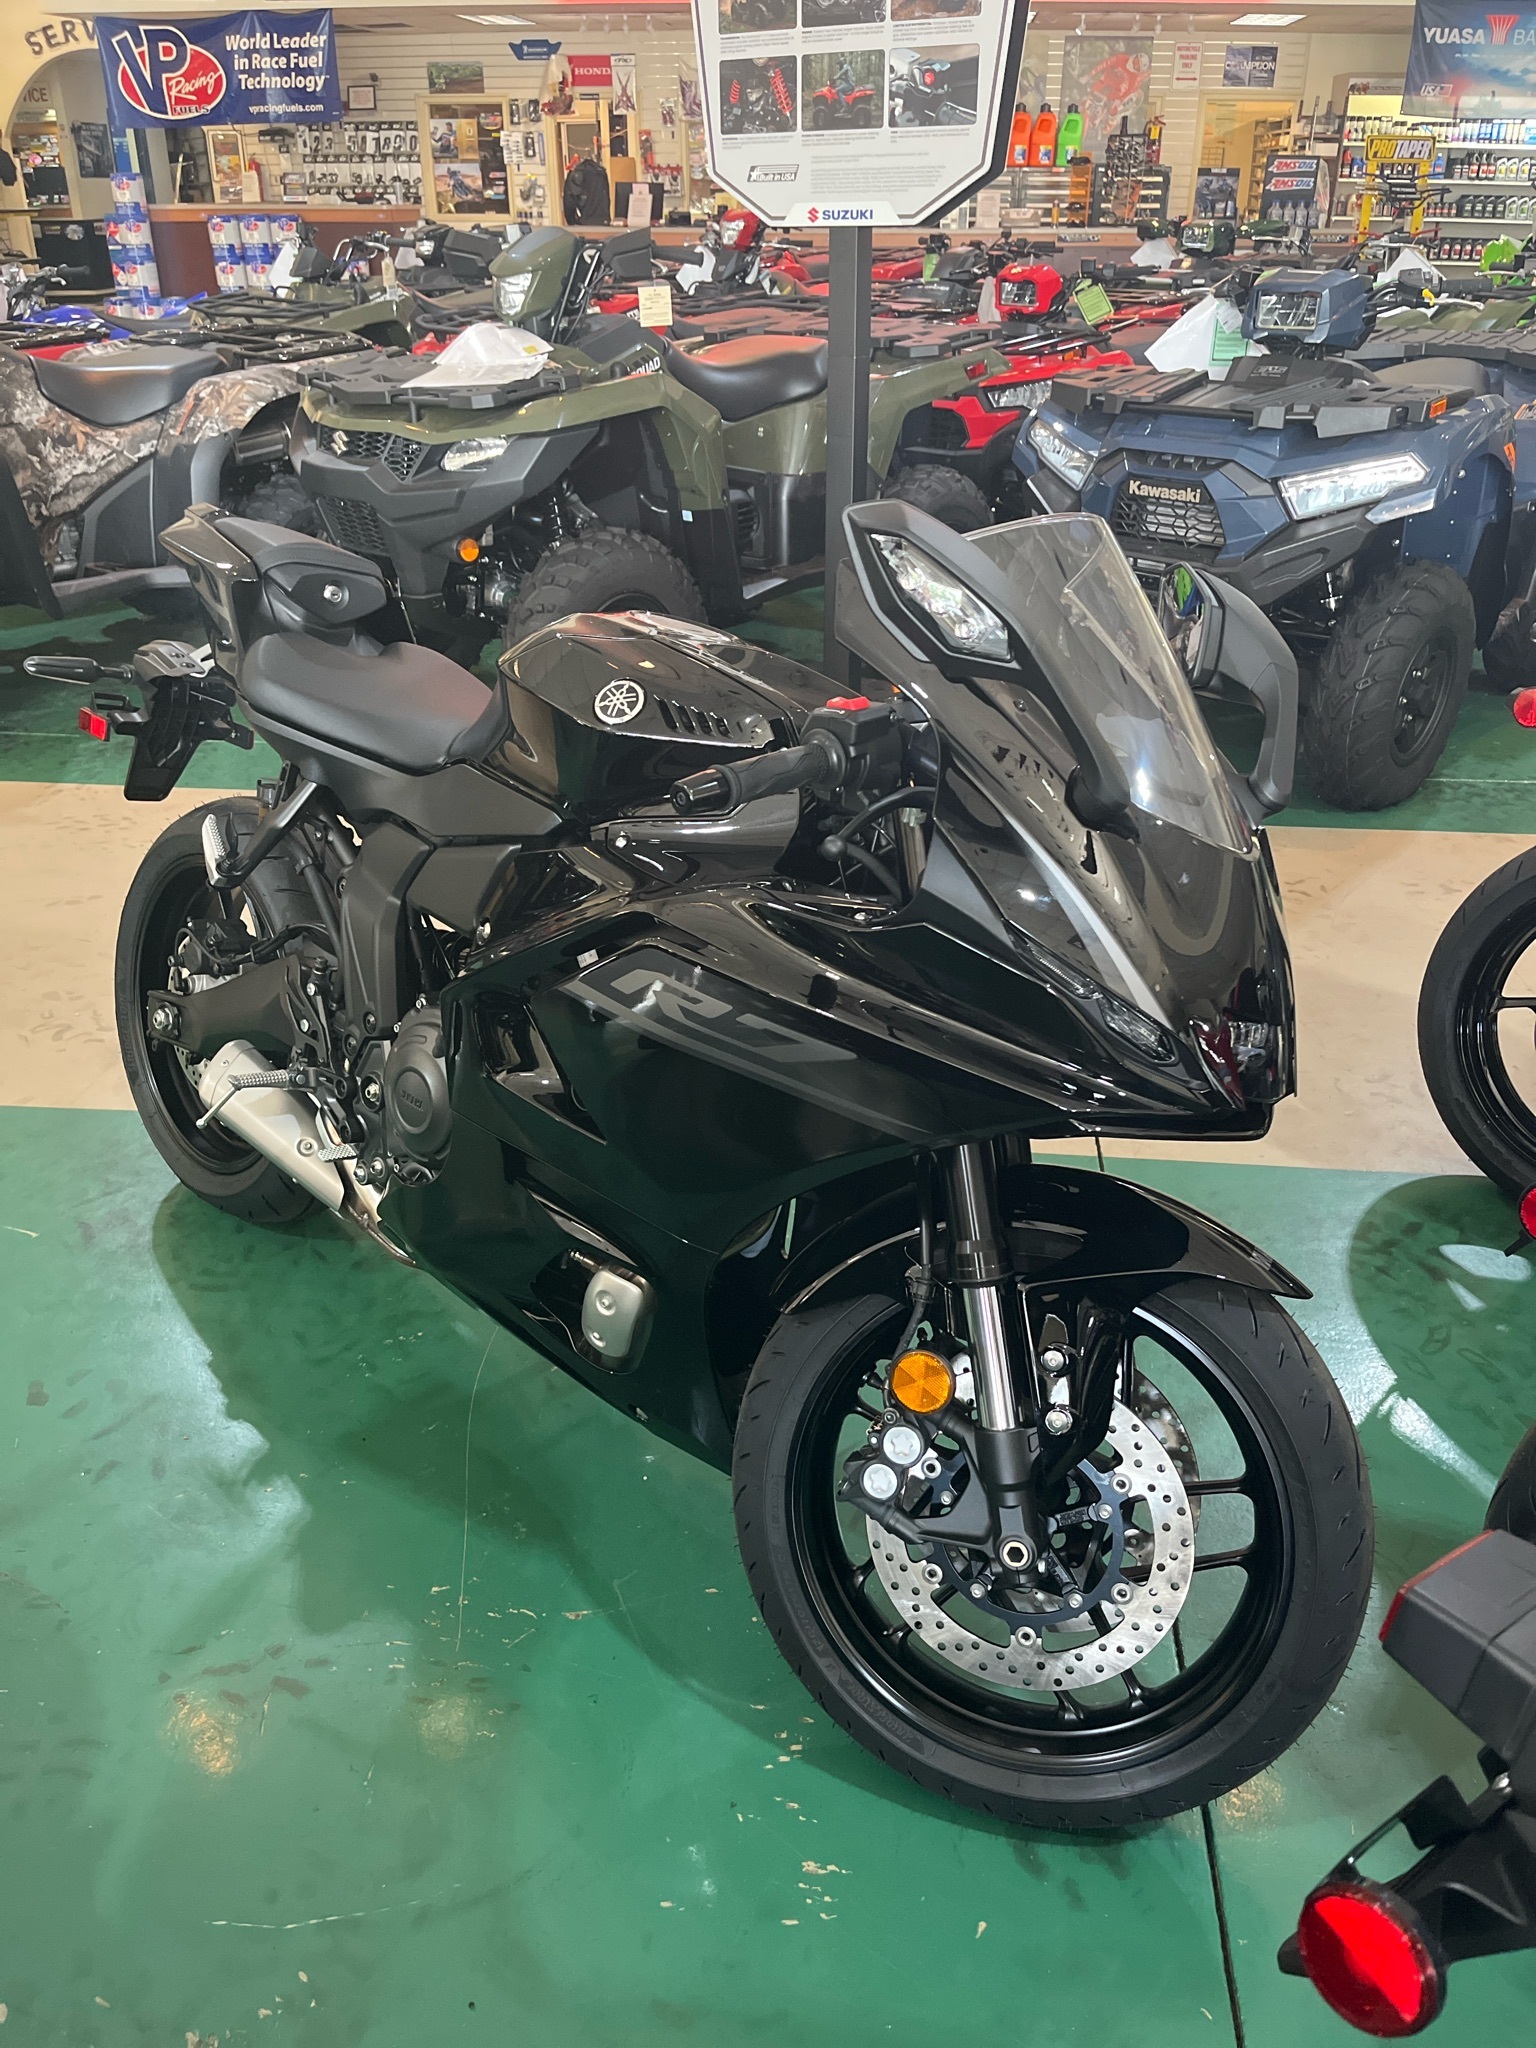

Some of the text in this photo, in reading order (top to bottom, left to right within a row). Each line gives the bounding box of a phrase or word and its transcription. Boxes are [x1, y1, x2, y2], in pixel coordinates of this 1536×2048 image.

[225, 32, 327, 51] World Leader
[1423, 27, 1486, 44] YUASA
[233, 51, 323, 71] in Race Fuel
[111, 25, 191, 118] VP
[574, 67, 611, 75] HOND
[168, 71, 222, 106] Racing
[238, 72, 326, 92] Technology
[23, 87, 48, 103] ICE
[1420, 85, 1441, 97] USA
[172, 105, 211, 115] FUELS
[249, 103, 324, 115] vpracingfuels.com
[1271, 159, 1317, 171] AMSOIL
[781, 173, 795, 181] USA
[1269, 178, 1315, 189] AMSOIL
[822, 209, 874, 221] SUZUKI
[632, 356, 661, 374] QUAD
[1129, 480, 1201, 503] Kawasaki
